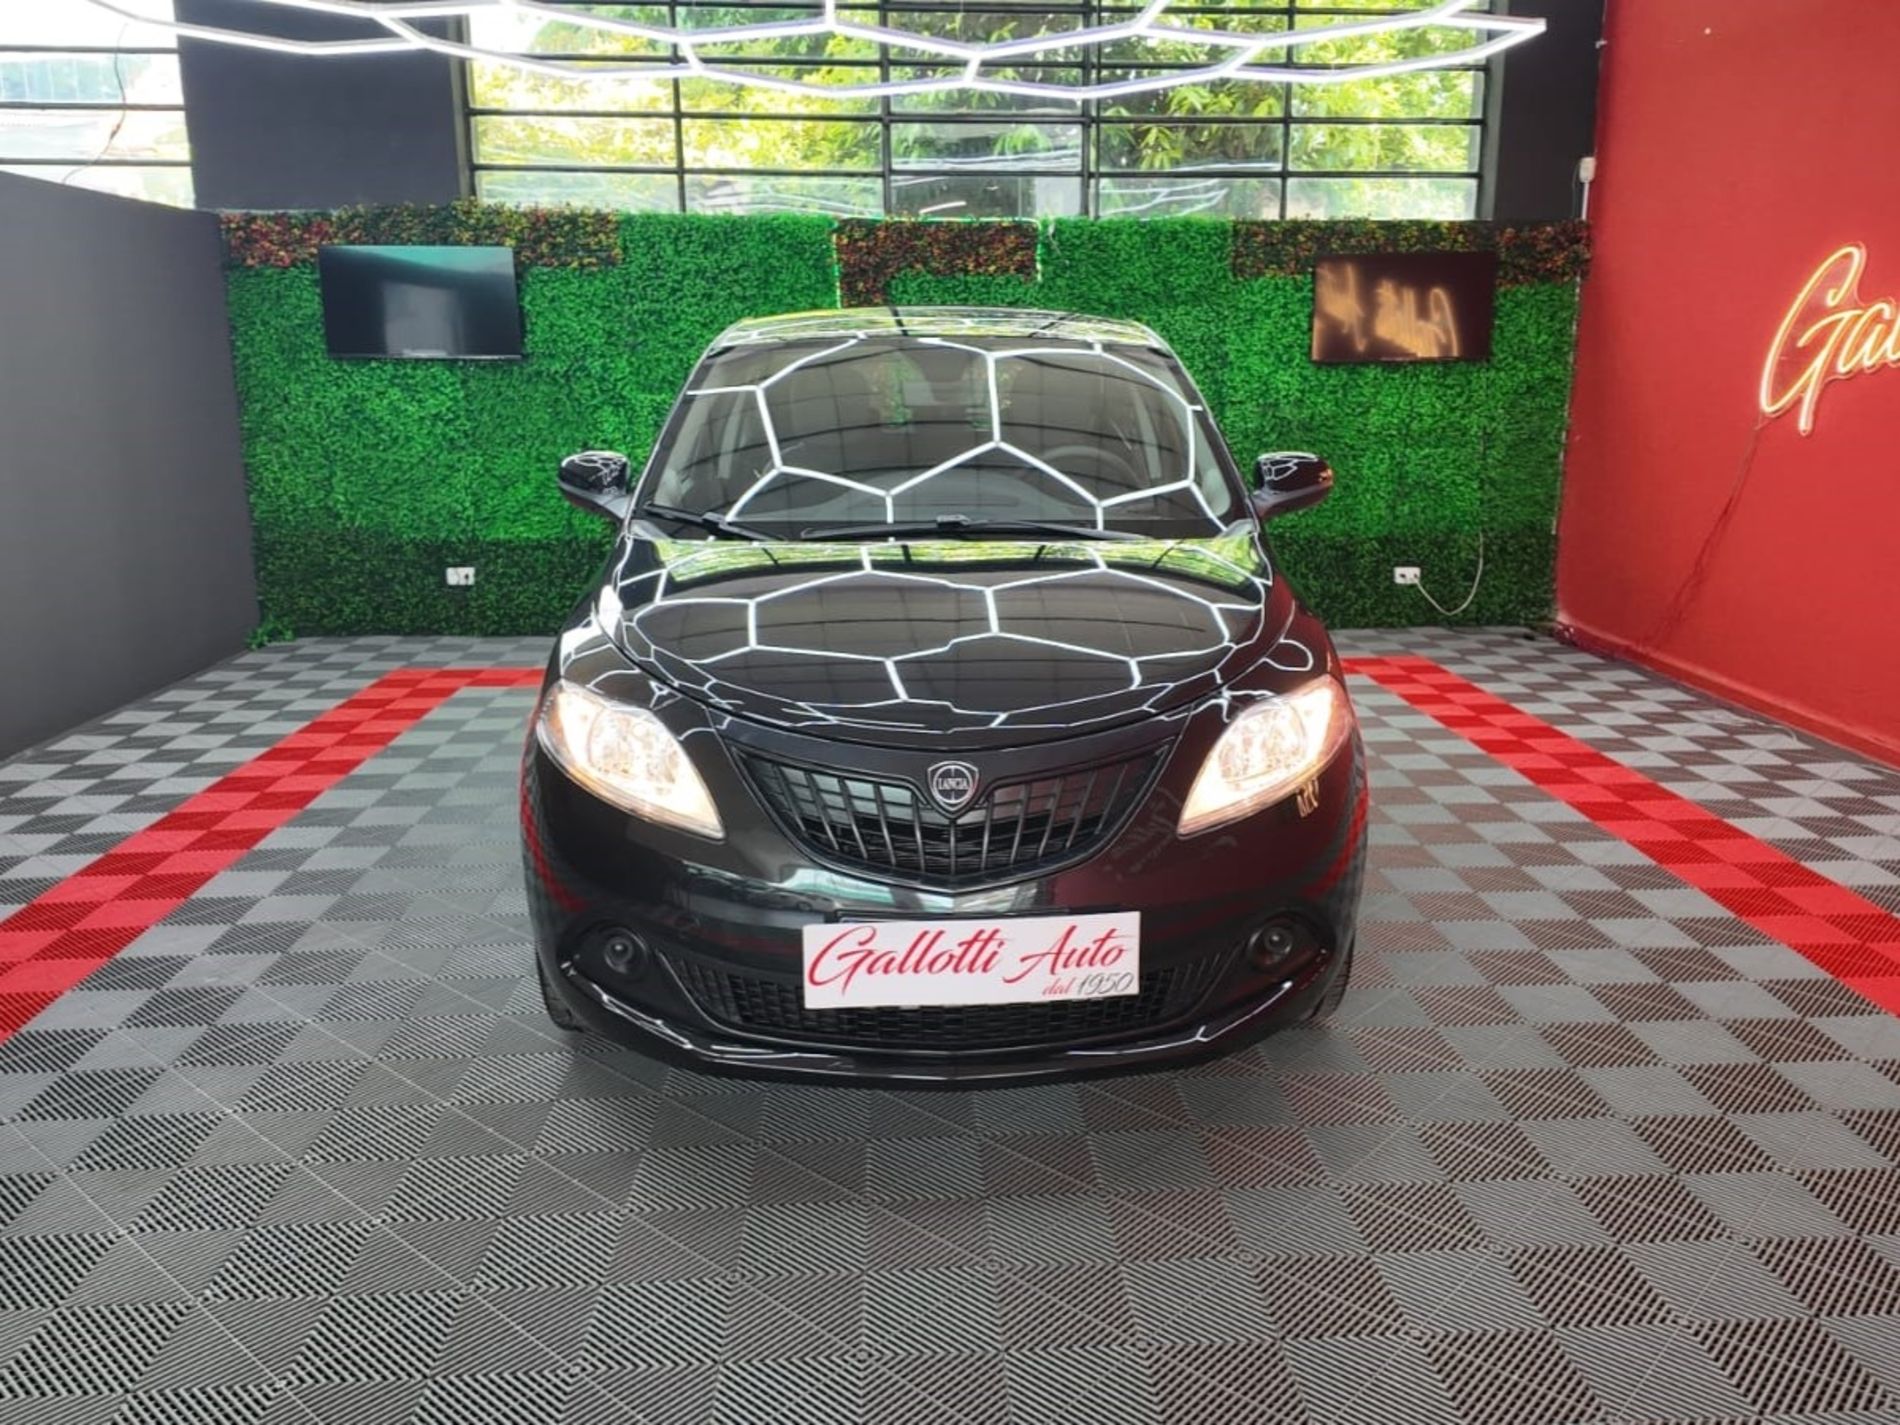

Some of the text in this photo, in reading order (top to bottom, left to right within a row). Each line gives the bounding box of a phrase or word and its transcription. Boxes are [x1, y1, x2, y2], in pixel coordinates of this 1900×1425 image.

[807, 924, 1138, 996] Gallotti Auto
[1042, 971, 1135, 996] dal 1950
